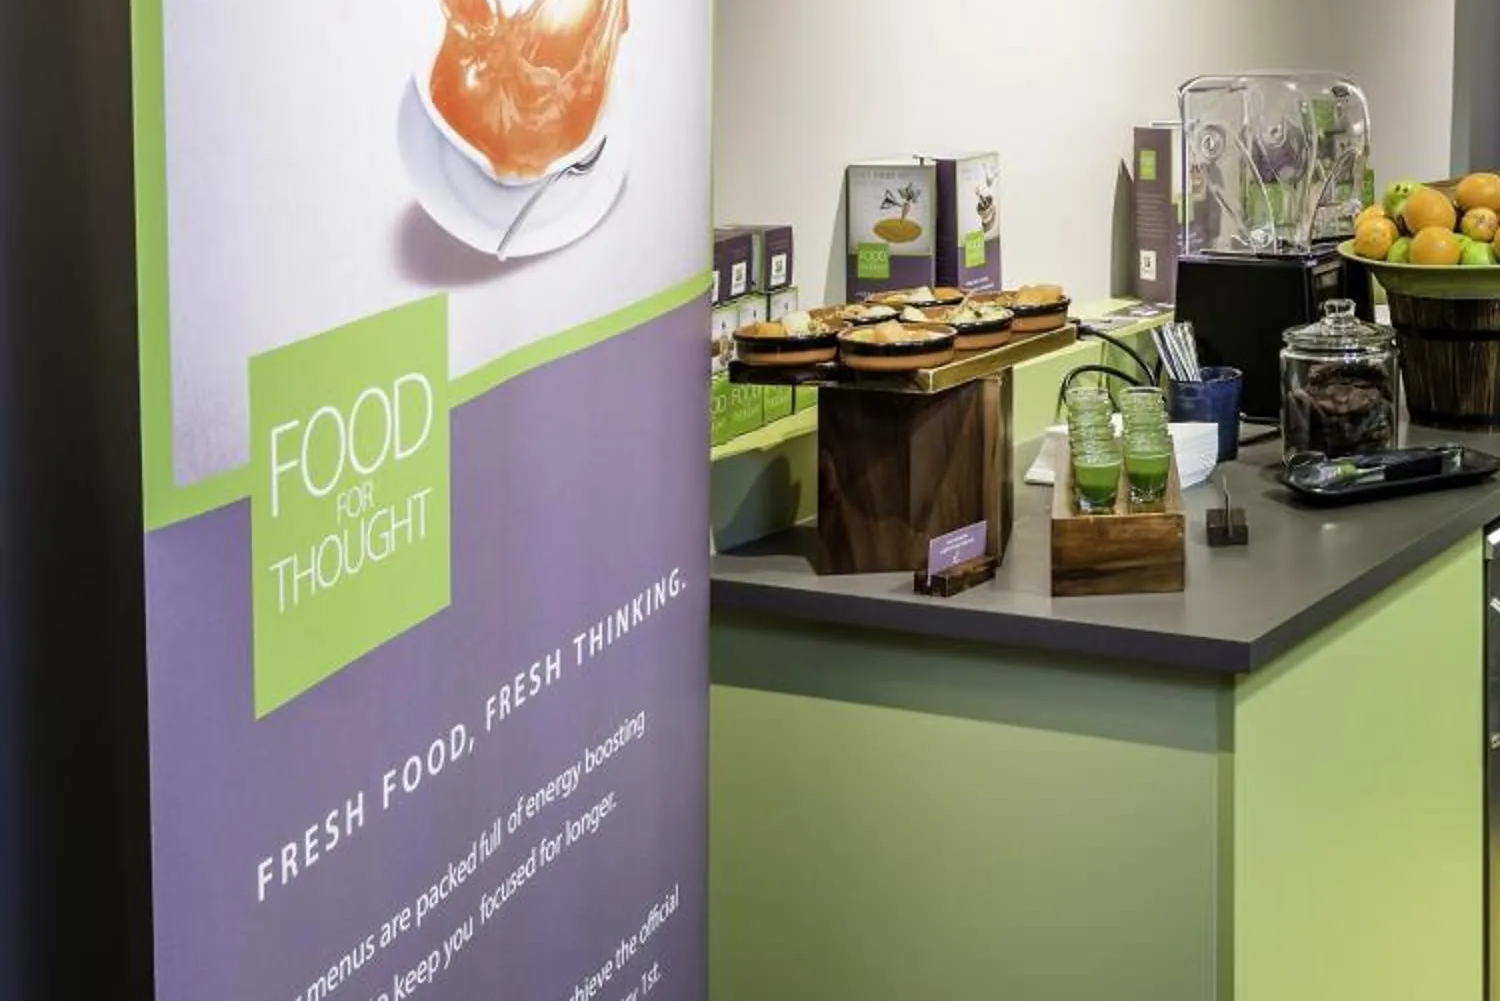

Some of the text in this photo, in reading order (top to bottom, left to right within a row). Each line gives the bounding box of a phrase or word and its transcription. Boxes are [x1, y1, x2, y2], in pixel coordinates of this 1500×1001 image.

[270, 371, 434, 519] FOOD
[336, 479, 374, 526] FOR
[268, 486, 434, 614] THOUGHT
[256, 567, 687, 903] FRESH FOOD, FRESH THINKING.
[306, 710, 646, 1001] menus are packed full of energy boosting
[391, 791, 618, 1001] keep you focused for longer.
[615, 934, 637, 970] the
[638, 882, 679, 945] official
